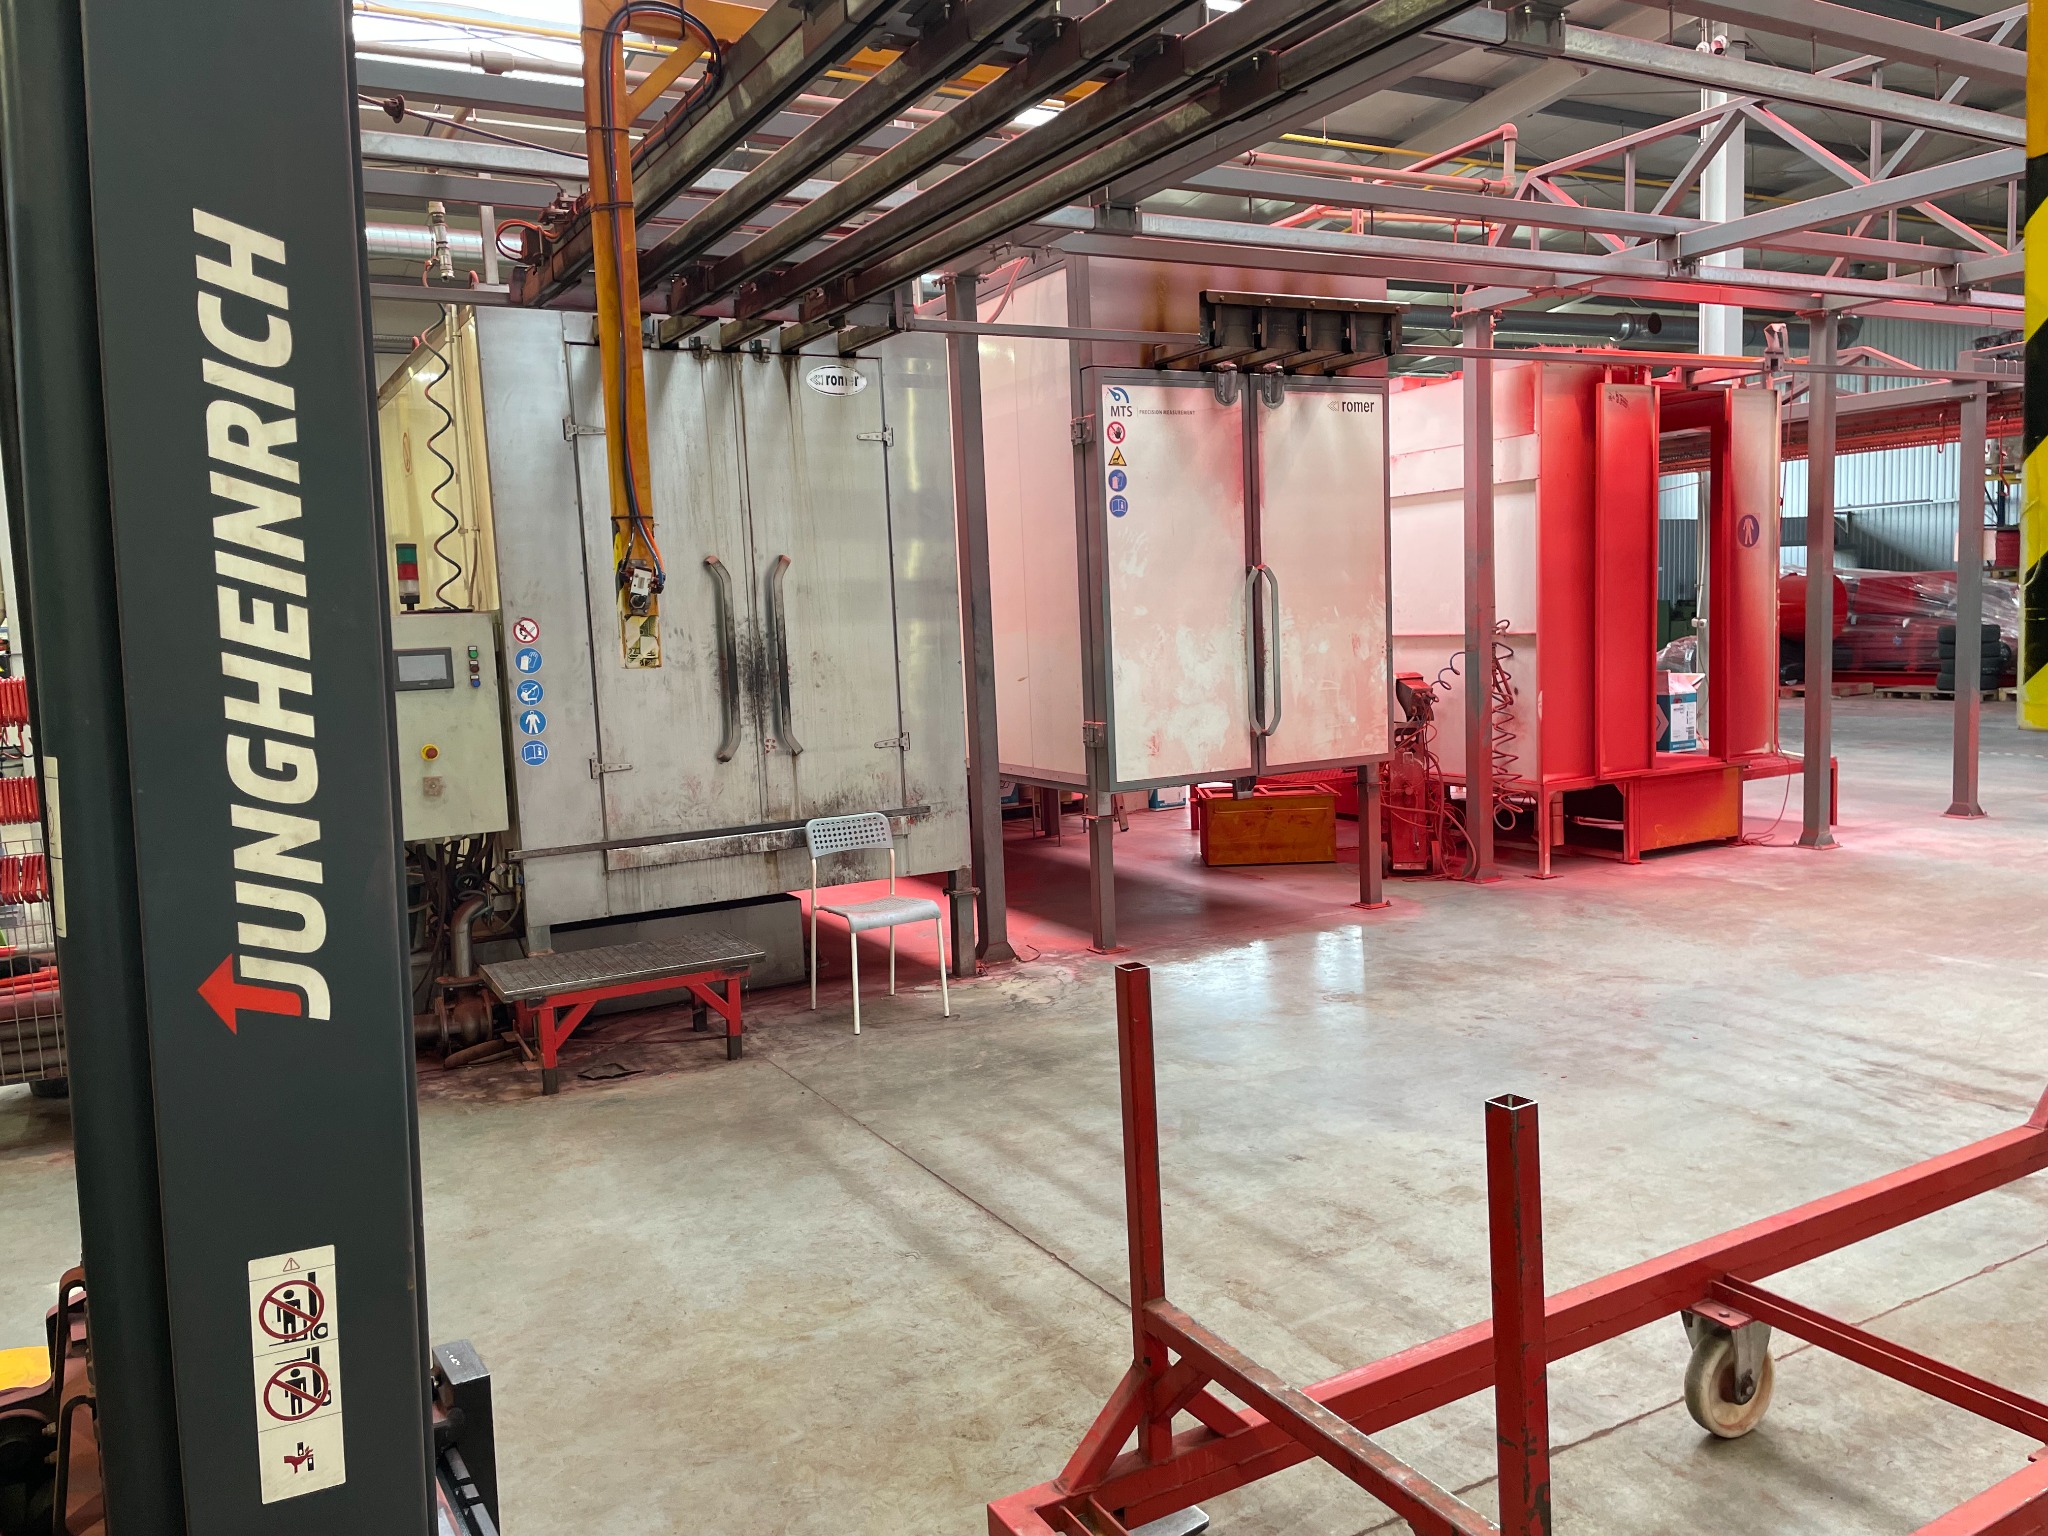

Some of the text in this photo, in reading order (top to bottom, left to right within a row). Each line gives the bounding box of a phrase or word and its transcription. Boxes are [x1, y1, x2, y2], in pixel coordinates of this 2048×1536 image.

[1110, 405, 1133, 417] MTS
[1341, 401, 1375, 413] romer
[193, 208, 331, 1021] JUNGHEINRICH
